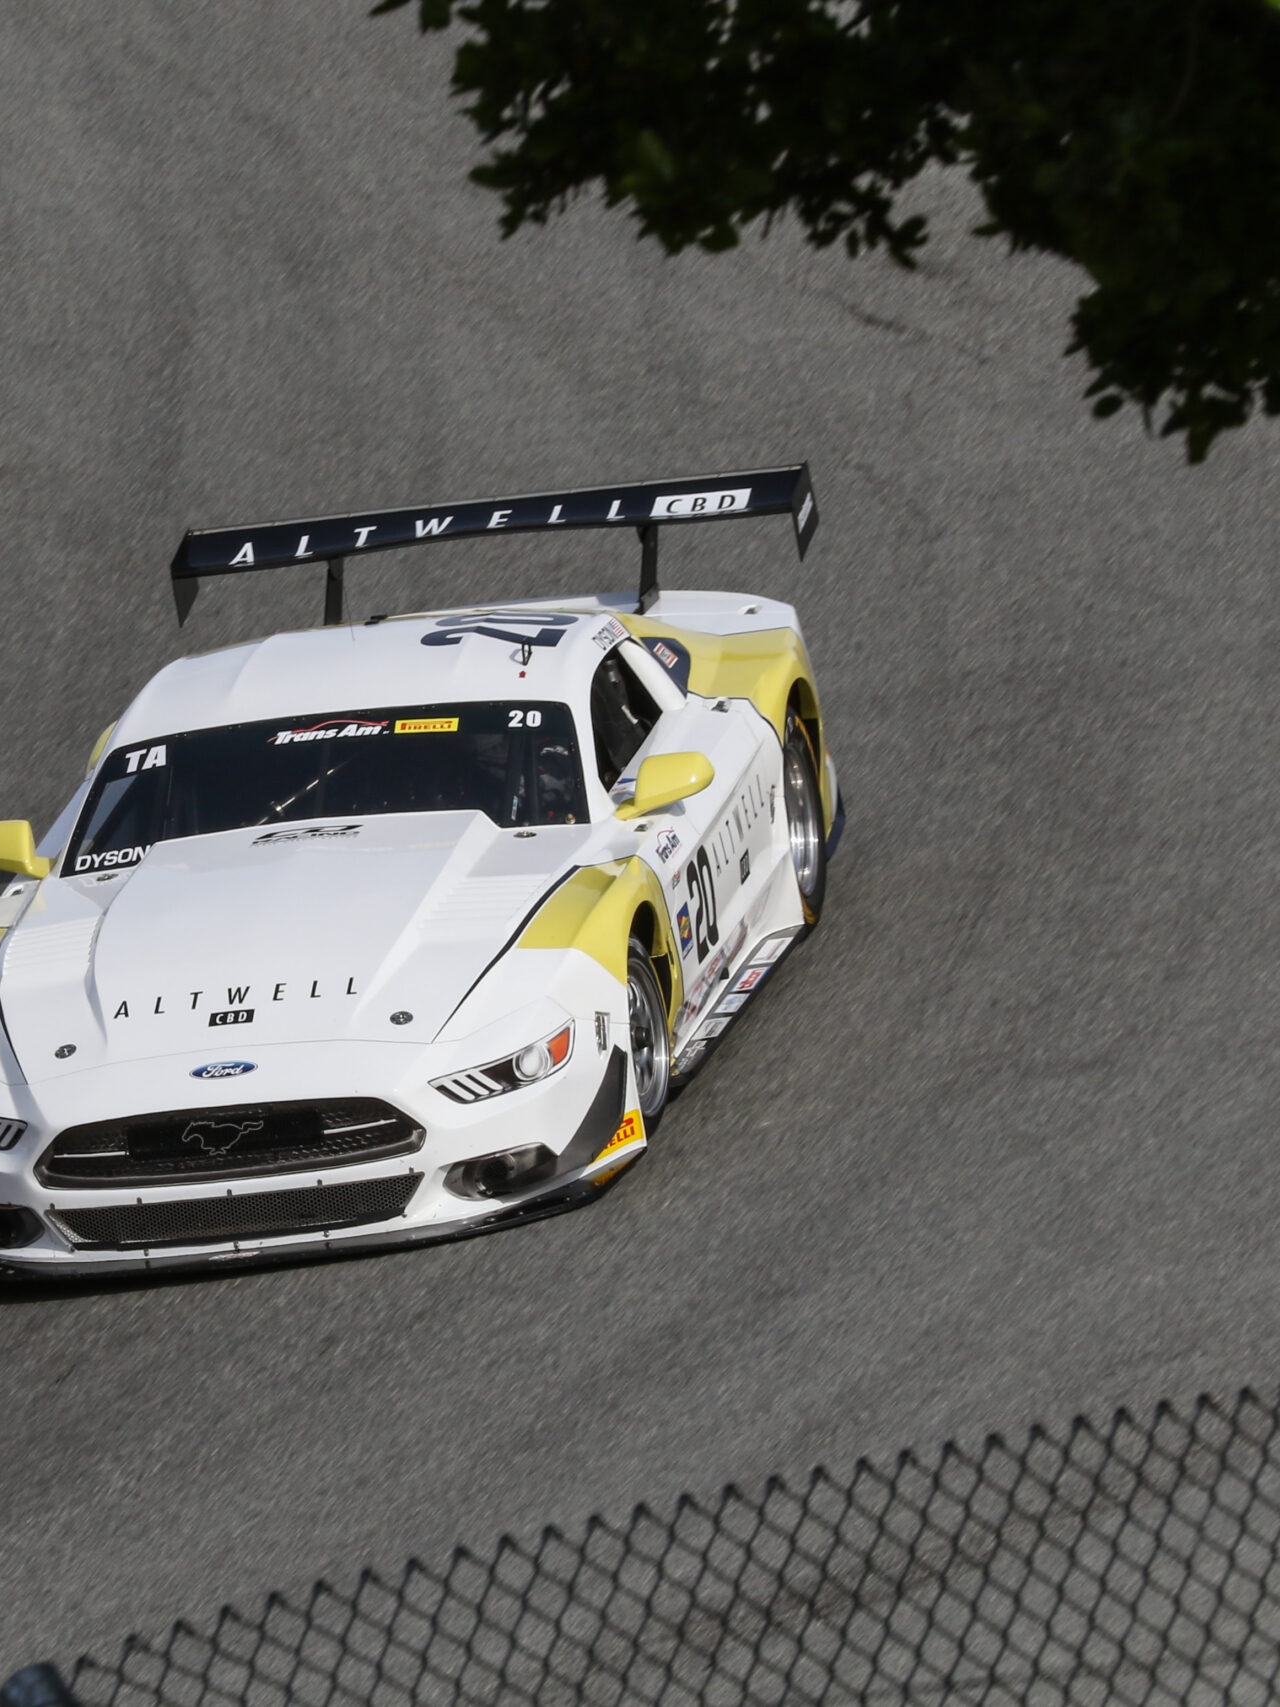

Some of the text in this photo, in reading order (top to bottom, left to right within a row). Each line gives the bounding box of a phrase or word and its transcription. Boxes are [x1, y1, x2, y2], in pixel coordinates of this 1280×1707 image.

[666, 494, 737, 514] CBD
[228, 499, 627, 567] ALTWELL
[400, 720, 454, 731] PIRELLI
[507, 710, 543, 728] 20
[273, 723, 383, 746] Trans Am
[125, 744, 168, 774] TA
[74, 845, 151, 872] DYSON
[686, 844, 720, 965] 20
[113, 976, 358, 1020] ALTWELL
[214, 1010, 248, 1025] CBD
[201, 1062, 245, 1079] Ford
